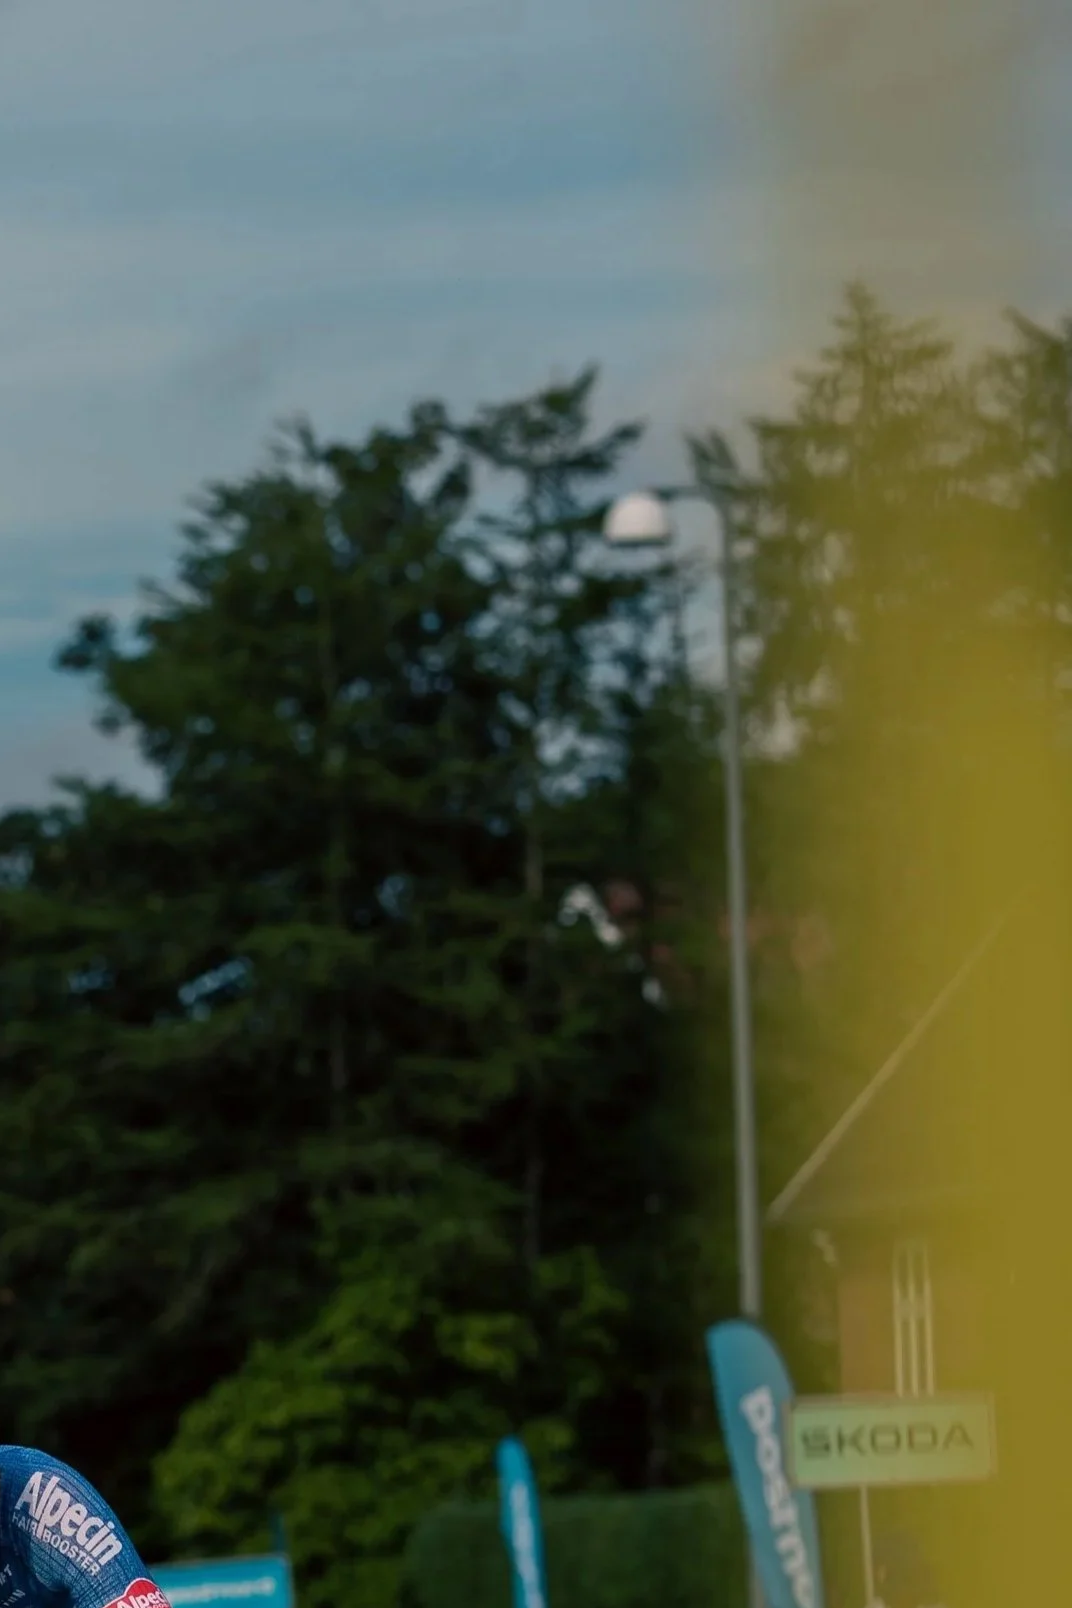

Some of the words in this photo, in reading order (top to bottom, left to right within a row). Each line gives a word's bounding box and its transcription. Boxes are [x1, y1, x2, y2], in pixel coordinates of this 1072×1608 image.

[12, 1512, 38, 1536] HAIR
[42, 1530, 101, 1577] BOOSTER
[14, 1471, 123, 1566] Alpecin
